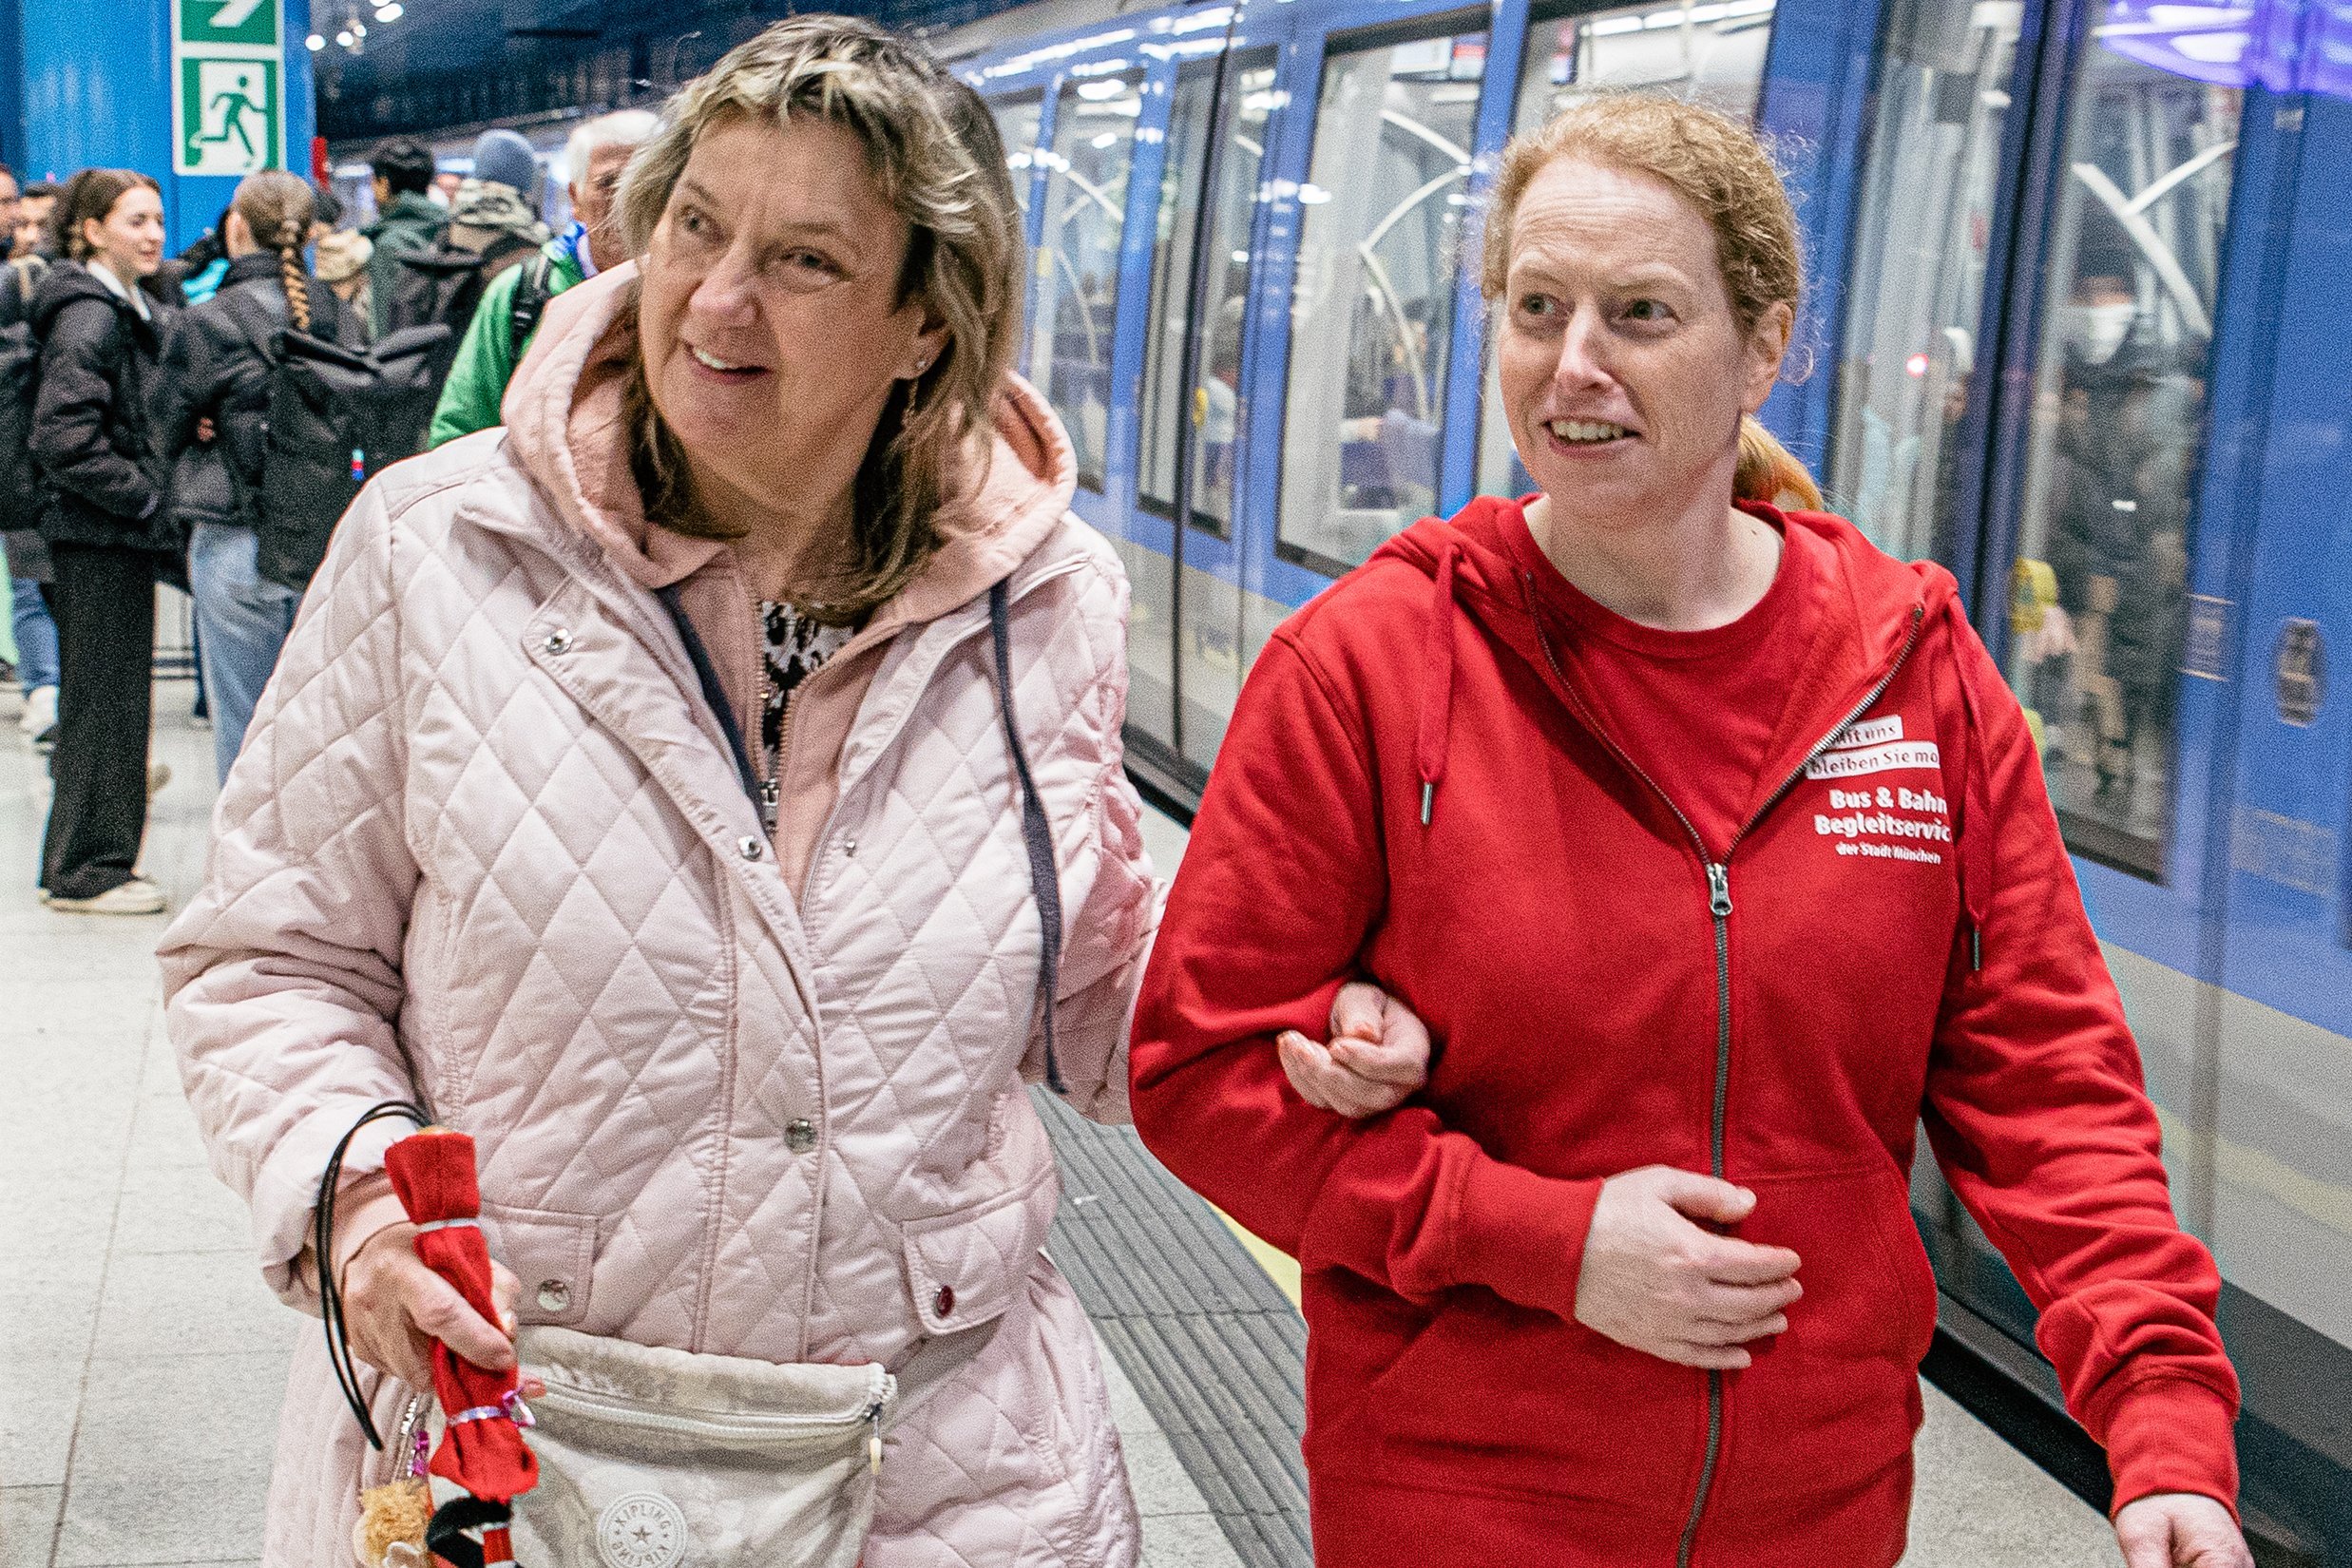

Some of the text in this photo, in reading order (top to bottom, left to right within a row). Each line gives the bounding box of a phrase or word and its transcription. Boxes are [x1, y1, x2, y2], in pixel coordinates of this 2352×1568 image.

[1864, 725, 1897, 741] uns
[1811, 749, 1939, 775] bleiben Sie mo
[1829, 786, 1948, 814] Bus & Bahn
[1814, 811, 1951, 843] Begleitservic
[1835, 841, 1941, 865] der Stadt München
[614, 1504, 673, 1530] KIPLING
